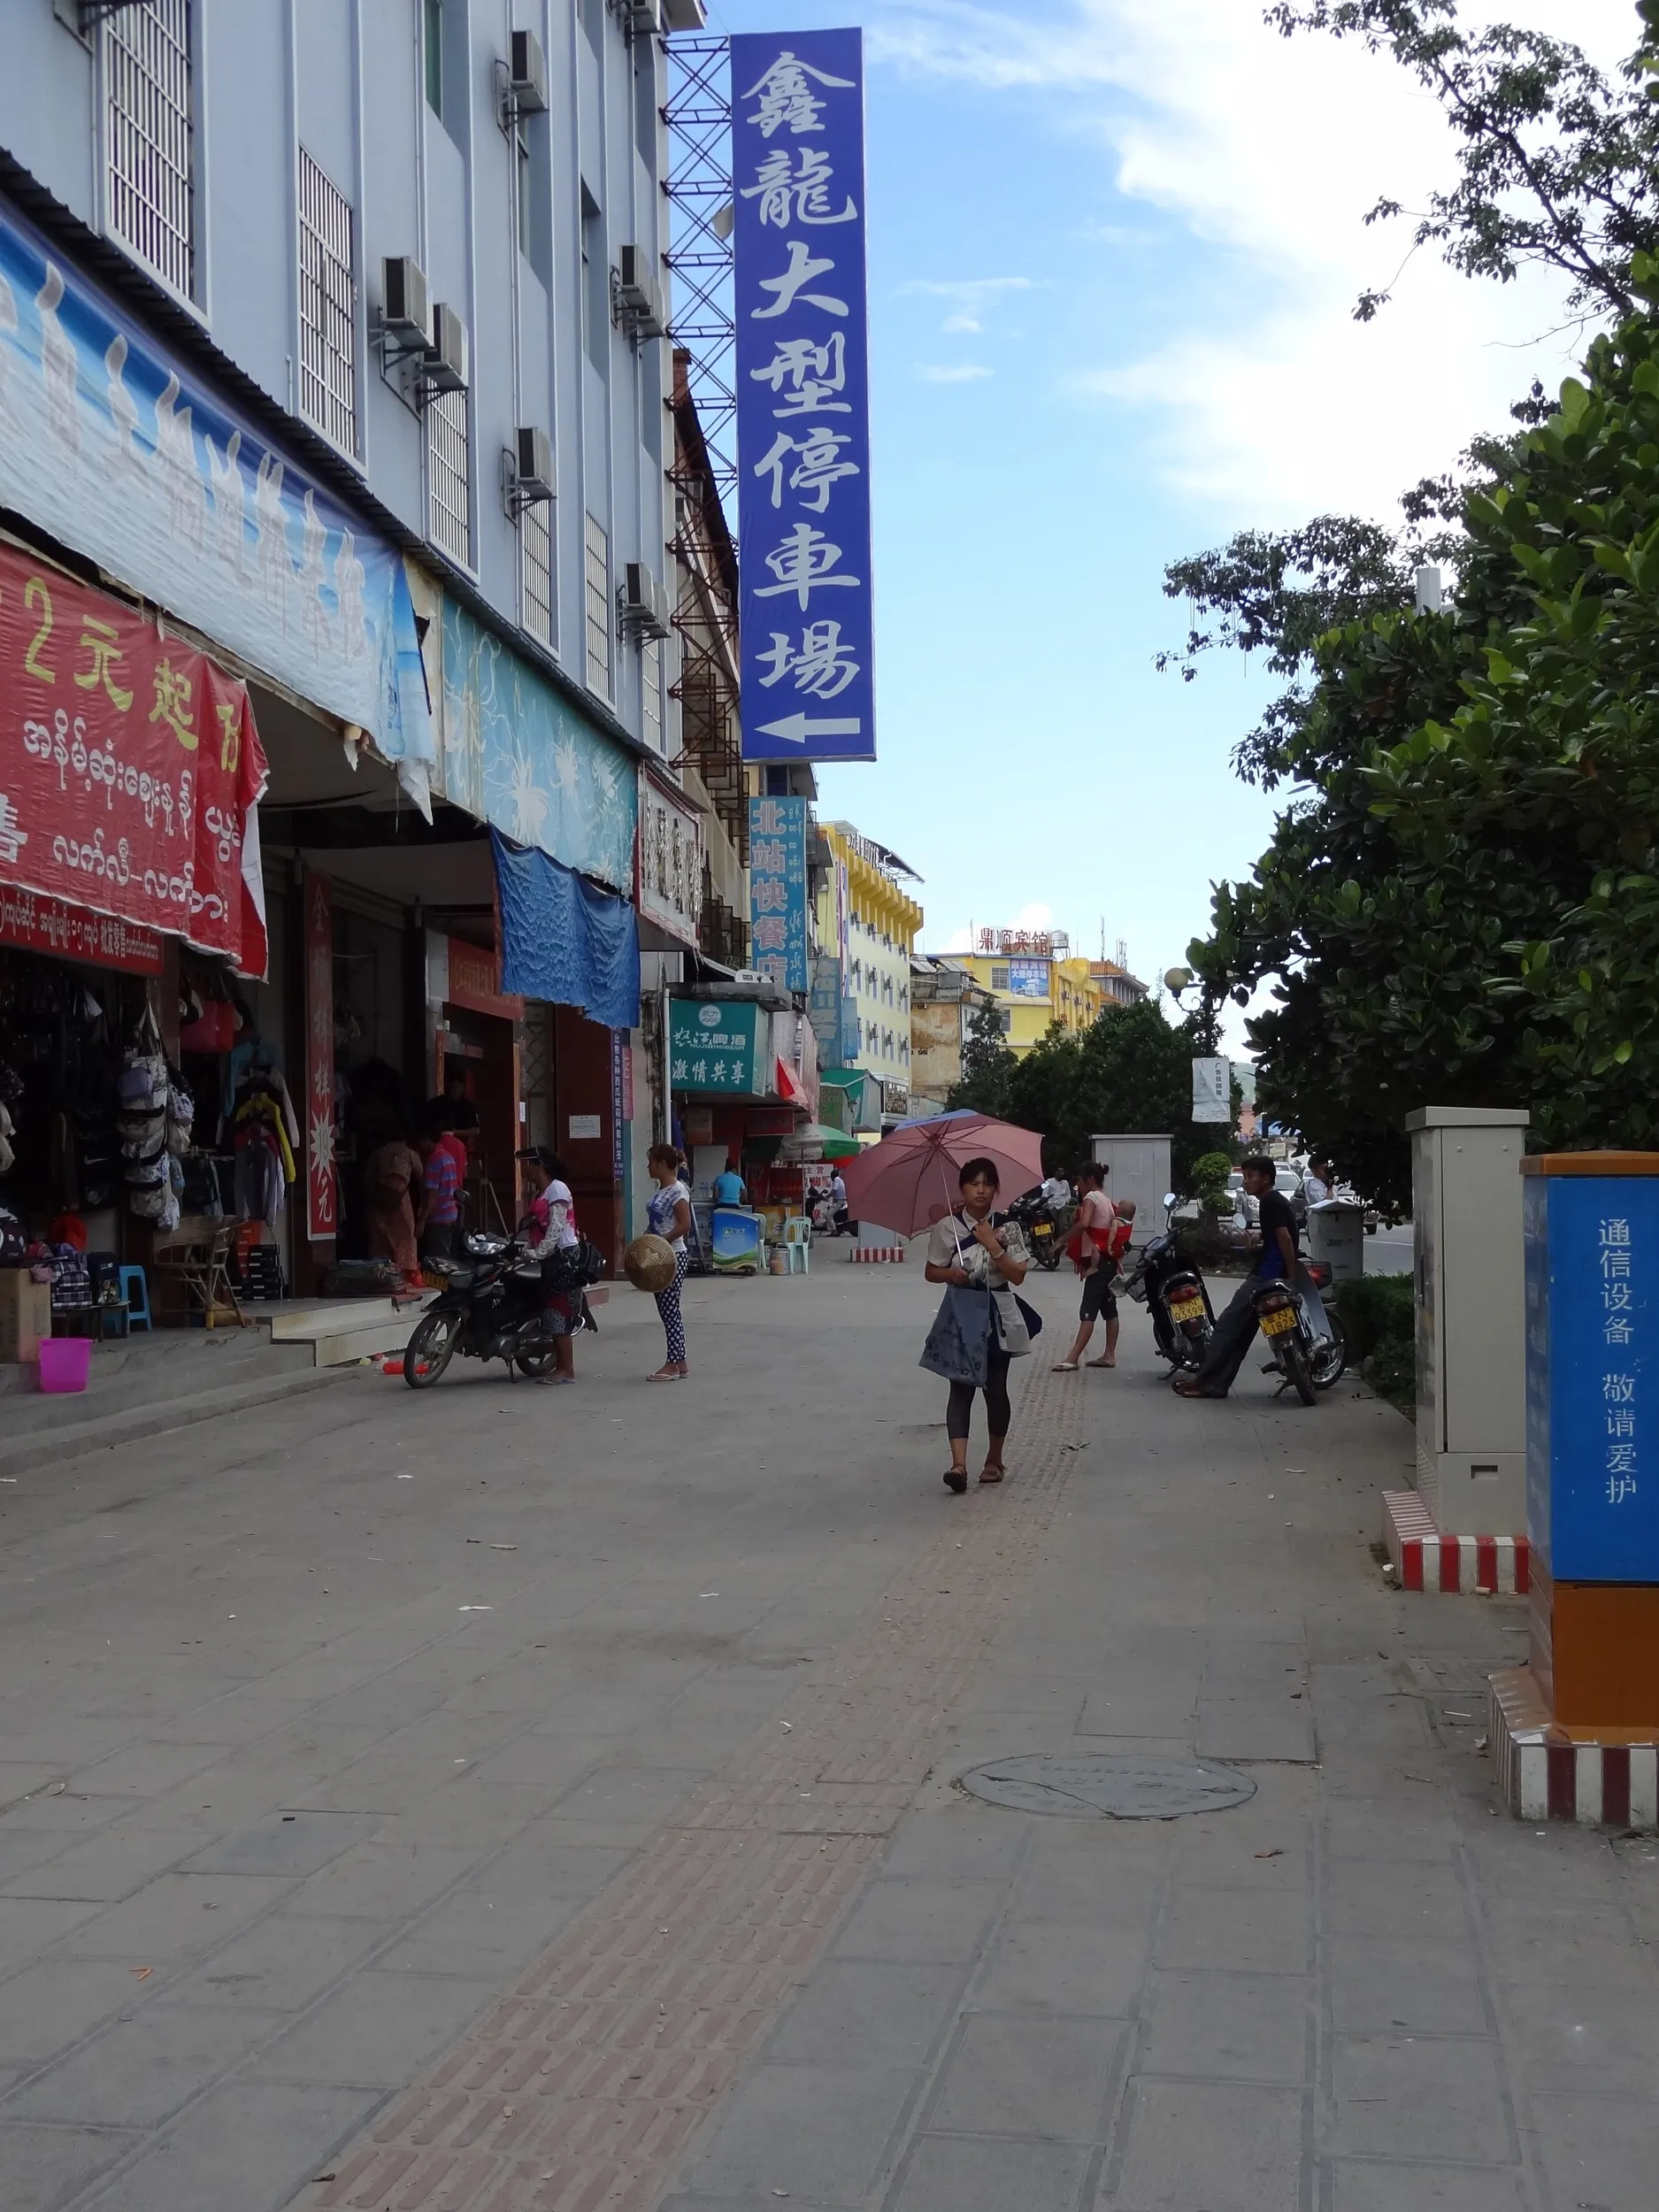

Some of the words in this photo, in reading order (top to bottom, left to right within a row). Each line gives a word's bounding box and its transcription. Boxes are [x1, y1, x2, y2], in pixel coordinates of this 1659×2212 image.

[740, 51, 861, 700] 鑫龍大型停車場
[979, 927, 1048, 956] 鼎顺宾馆
[672, 1058, 745, 1085] 激情共享
[673, 1027, 746, 1047] 怒江啤酒
[1599, 1218, 1634, 1345] 通信设备
[1602, 1373, 1638, 1503] 敬请爱护
